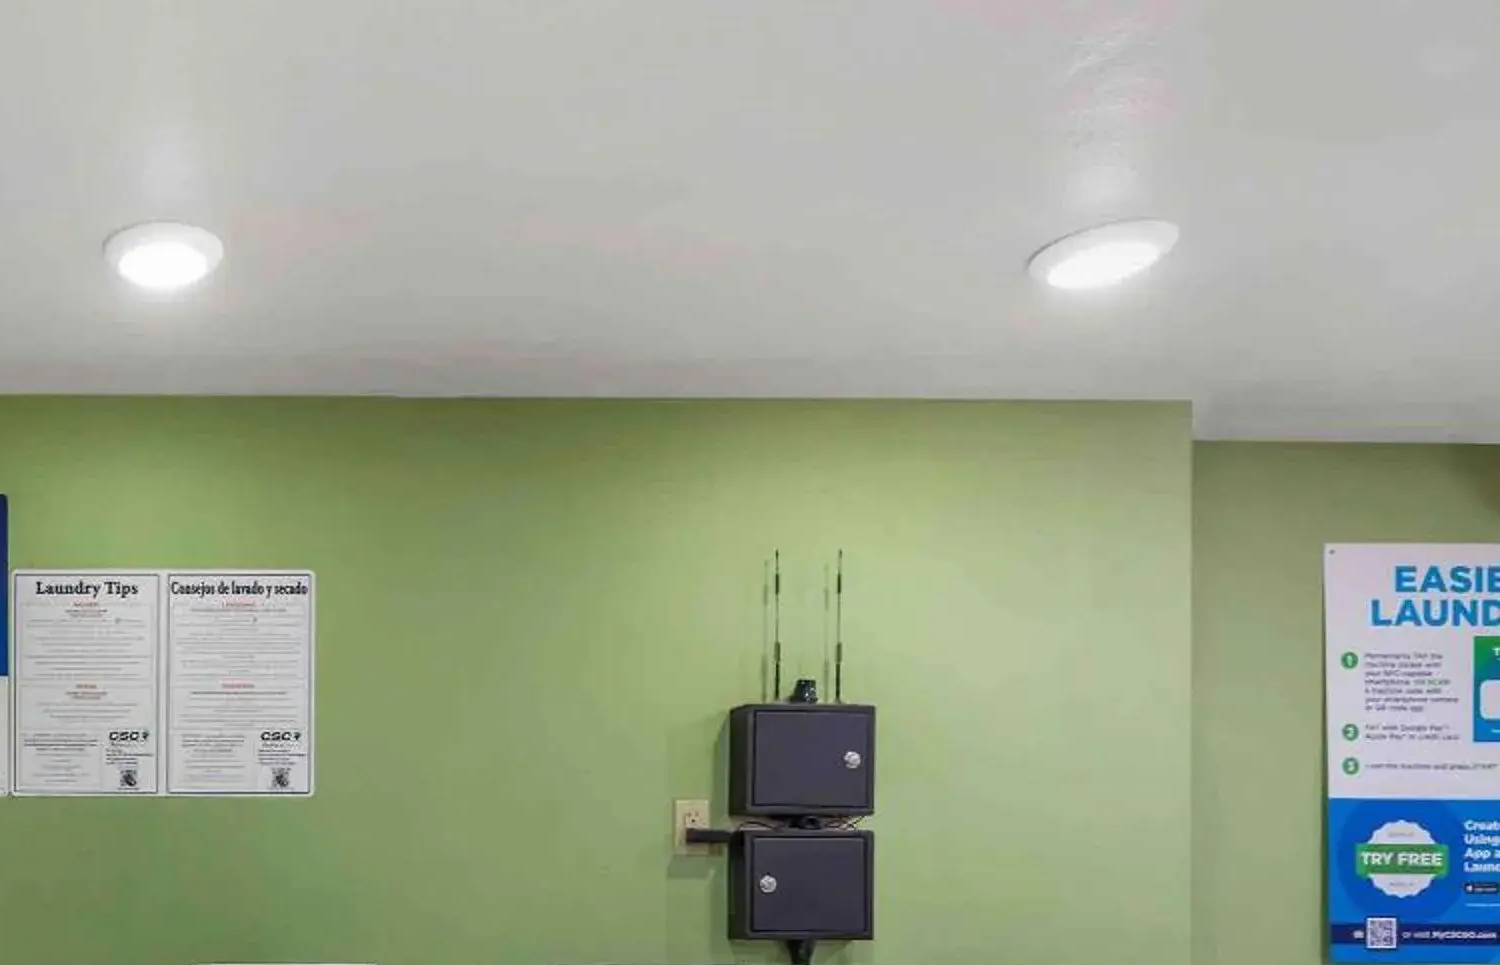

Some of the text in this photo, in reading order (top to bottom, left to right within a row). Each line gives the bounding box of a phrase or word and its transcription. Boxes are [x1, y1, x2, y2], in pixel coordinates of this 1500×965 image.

[1395, 565, 1500, 593] EASIE
[35, 581, 140, 599] Laundry Tips
[170, 580, 309, 598] Consejos de lavado y secado
[1371, 599, 1500, 627] LAUND
[109, 731, 140, 741] CSC
[260, 731, 292, 741] CSC
[1360, 852, 1444, 866] TRY FREE
